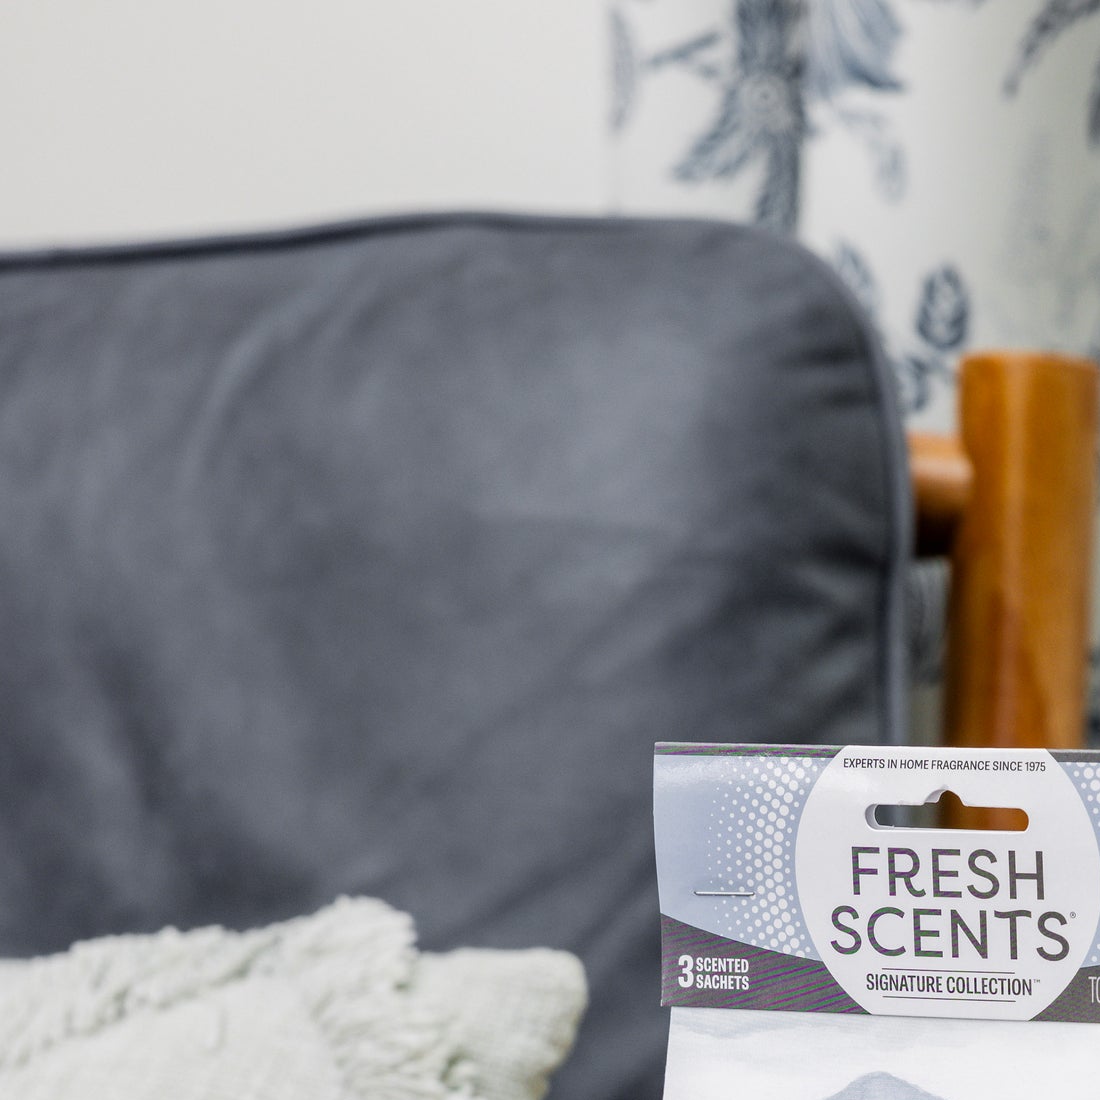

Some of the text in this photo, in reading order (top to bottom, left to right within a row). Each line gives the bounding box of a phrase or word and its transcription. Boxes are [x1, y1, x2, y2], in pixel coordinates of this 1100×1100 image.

[843, 758, 1046, 772] EXPERTS IN HOME FRAGRANCE SINCE 1975
[851, 846, 1045, 900] FRESH
[678, 954, 694, 988] 3
[696, 957, 749, 973] SCENTED
[696, 974, 750, 990] SACHETS
[866, 973, 943, 993] SIGNATURE
